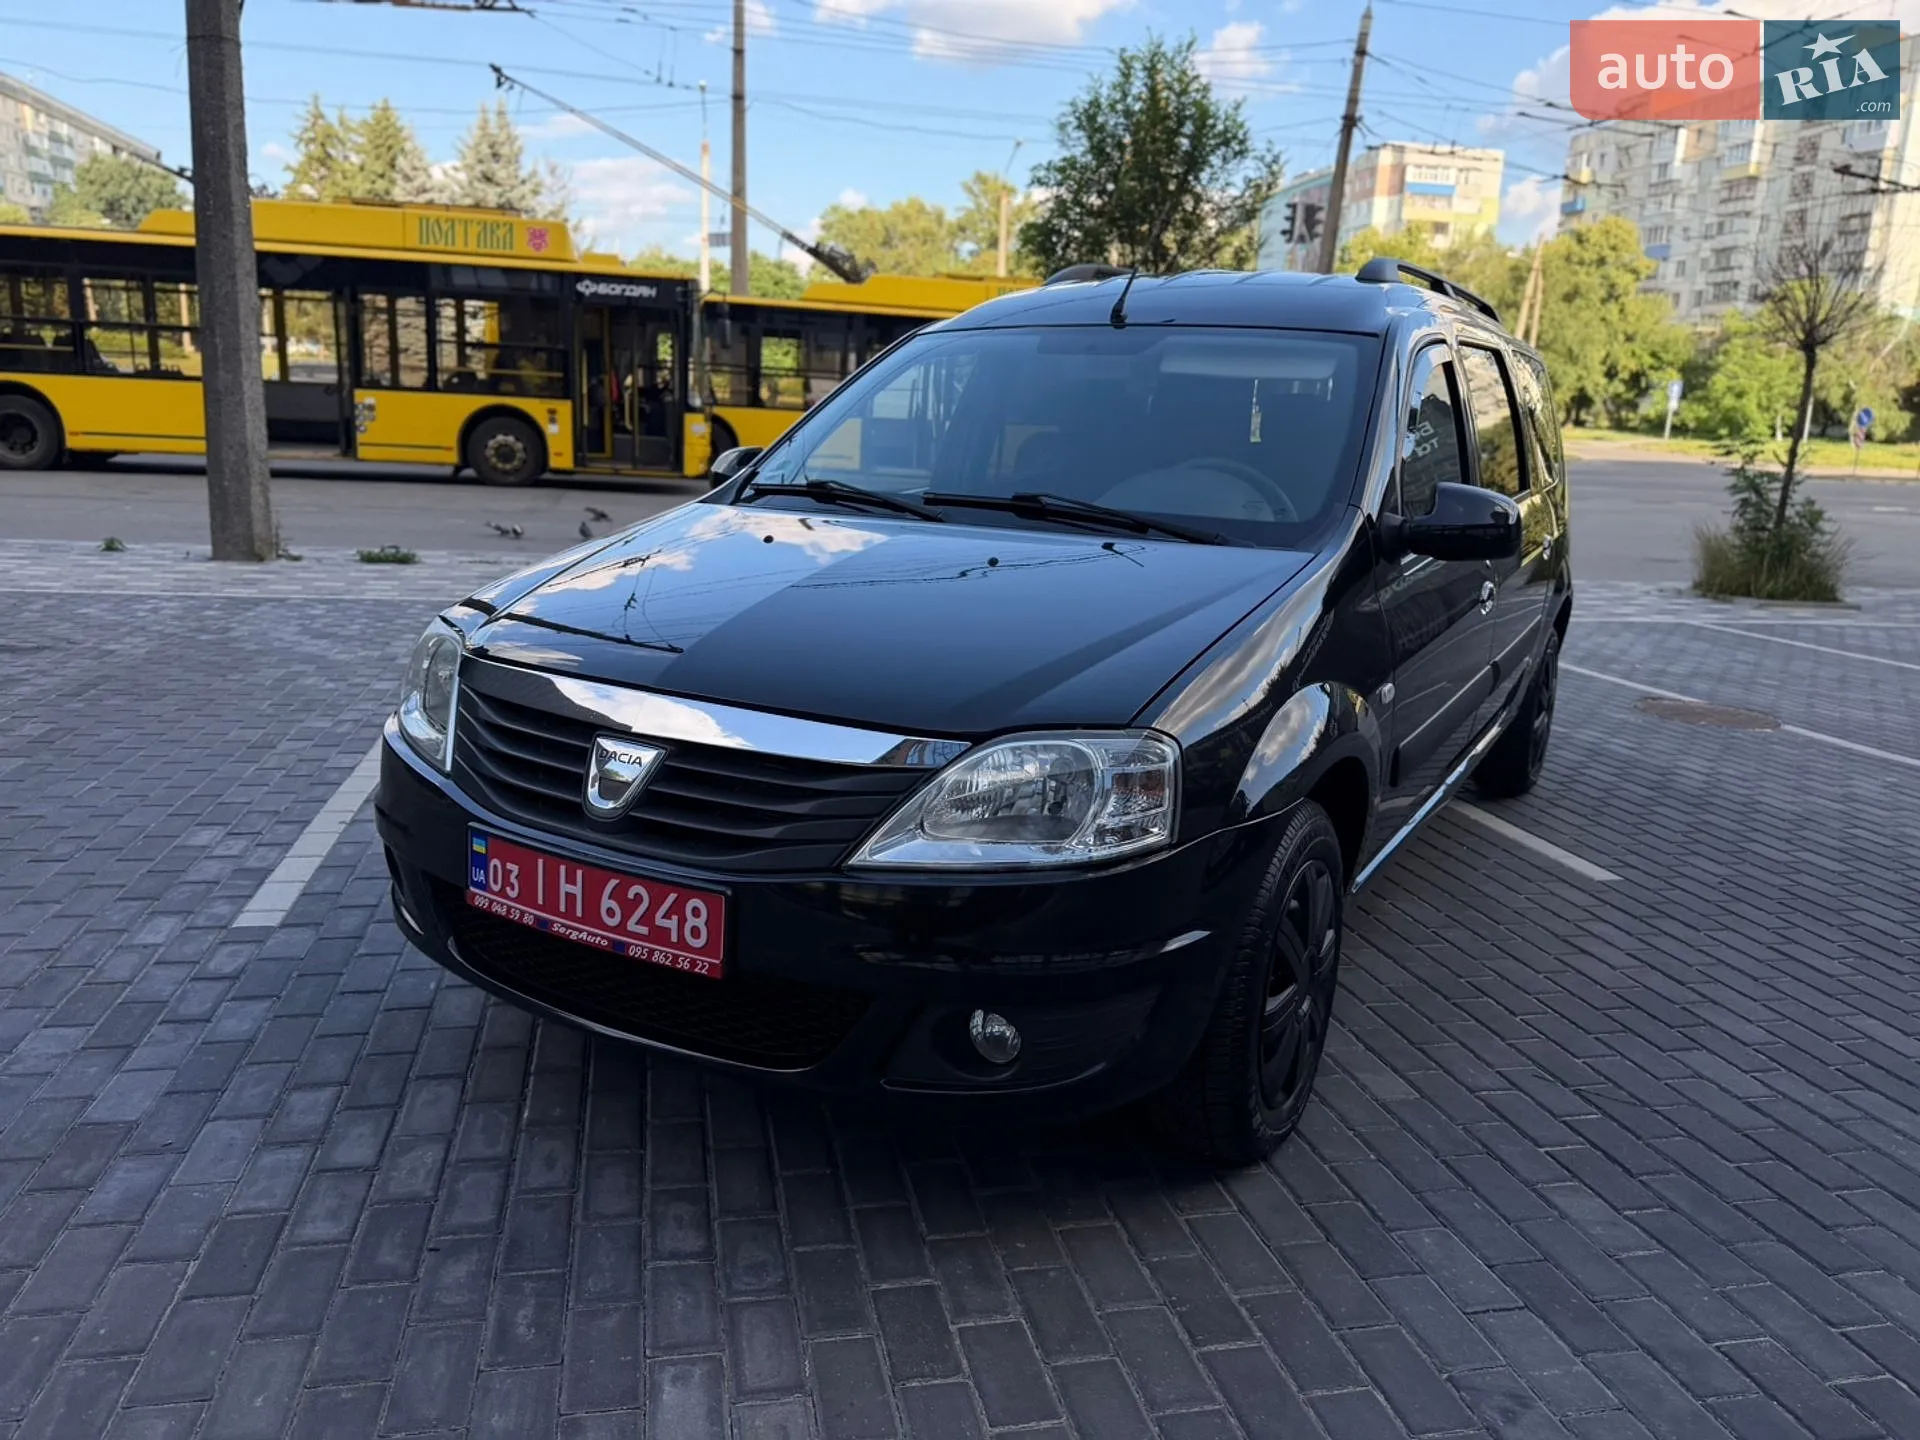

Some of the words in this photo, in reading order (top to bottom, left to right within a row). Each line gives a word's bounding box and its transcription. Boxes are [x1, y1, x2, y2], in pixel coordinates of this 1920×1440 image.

[419, 216, 514, 250] ПОЛТАВА
[598, 749, 642, 767] DACIA
[472, 866, 486, 884] UA
[489, 858, 519, 898] 03
[600, 878, 708, 948] 6248
[551, 922, 609, 946] SergAuto
[628, 945, 649, 959] 095
[652, 950, 673, 966] 862
[675, 957, 691, 970] 56
[694, 960, 709, 975] 22
